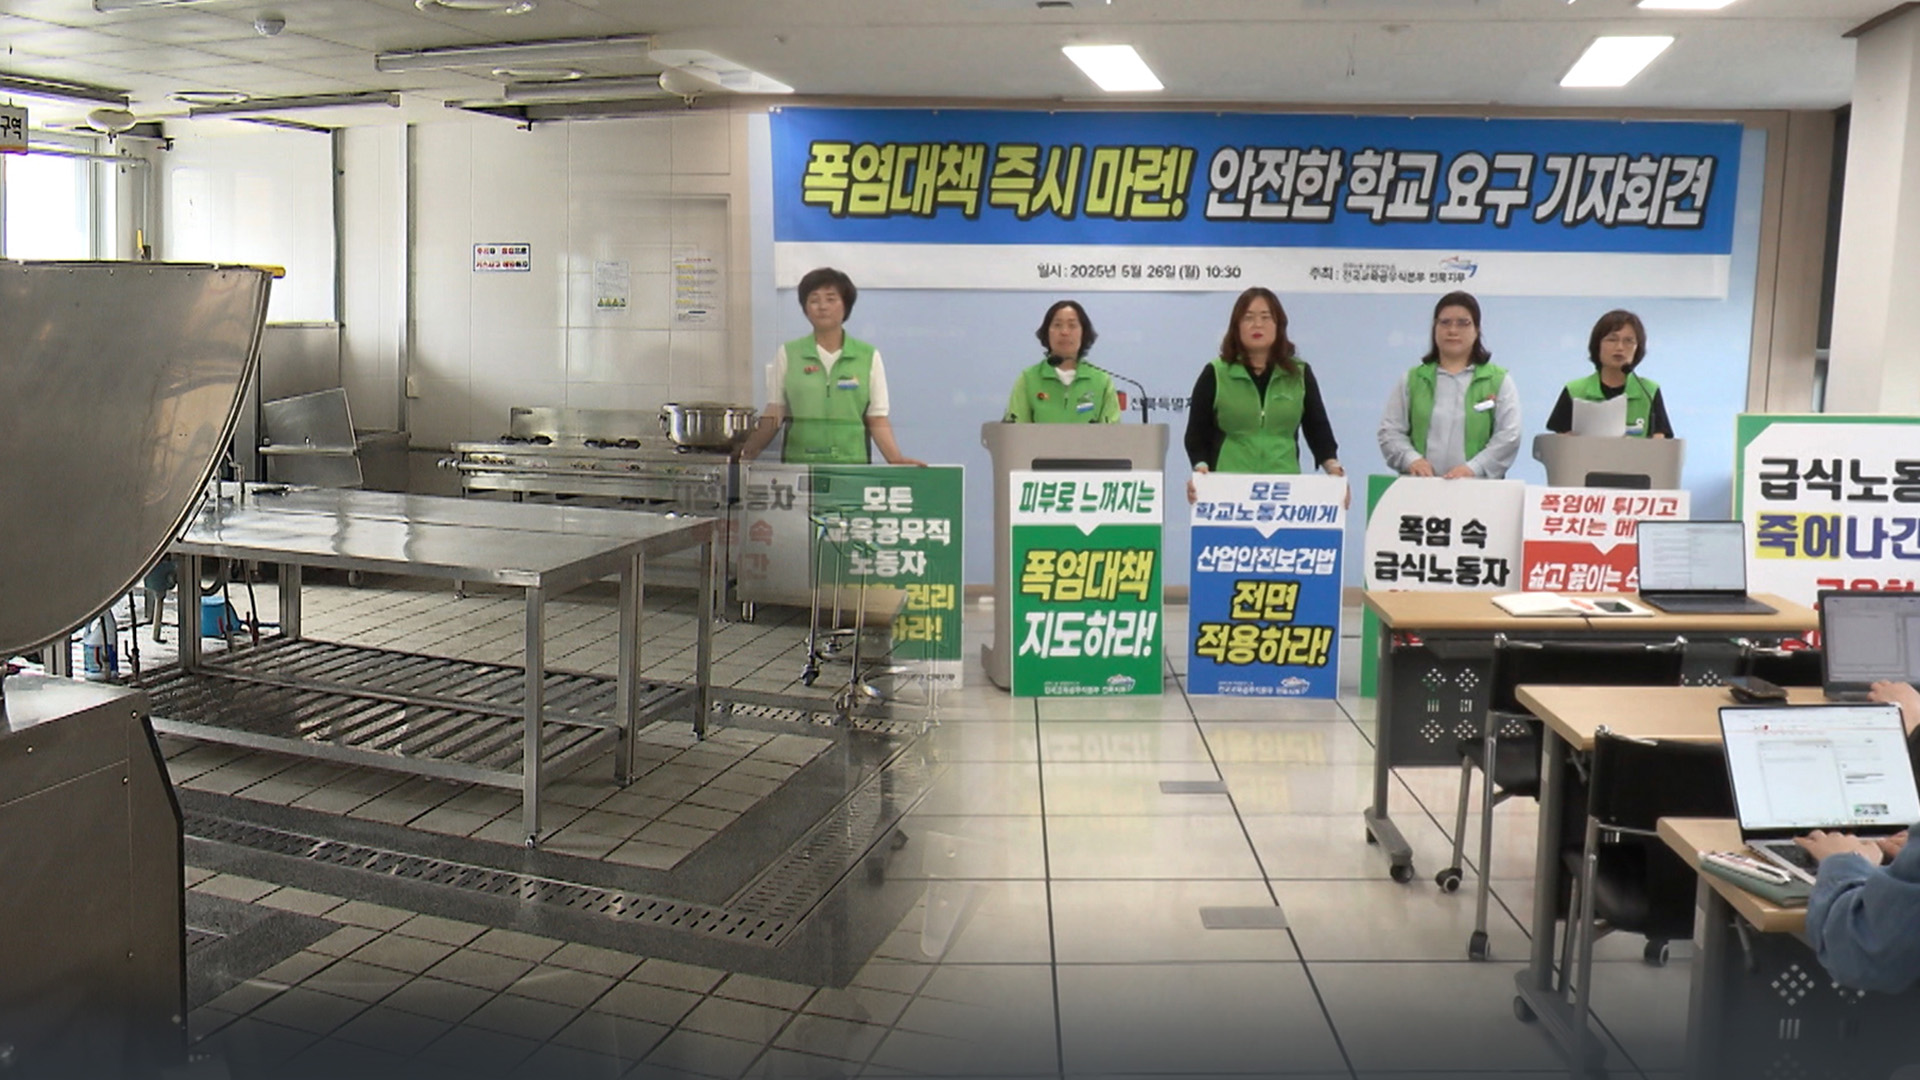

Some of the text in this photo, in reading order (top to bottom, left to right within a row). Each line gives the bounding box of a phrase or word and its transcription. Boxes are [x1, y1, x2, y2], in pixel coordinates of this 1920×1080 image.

[0, 115, 22, 140] 구역
[802, 142, 1715, 227] 폭염대책 즉시 마련! 안전한 학교 요구 기자회견
[1206, 265, 1241, 279] 10:30
[862, 486, 914, 513] 모든
[1018, 480, 1155, 513] 피부로 느껴지는
[1249, 481, 1291, 502] 모든
[1540, 494, 1679, 517] 폭염에 튀기고
[1195, 501, 1338, 524] 학교노동자에게
[1542, 516, 1607, 537] 부치는
[1398, 514, 1488, 549] 폭염 속
[849, 550, 927, 577] 노동자
[1020, 548, 1155, 602] 폭염대책
[1196, 544, 1337, 576] 산업안전보건법
[1373, 550, 1510, 588] 급식노동자
[1527, 561, 1567, 591] 삶고
[905, 583, 955, 611] 권리
[1230, 579, 1300, 621] 전면
[1018, 609, 1158, 659] 지도하라!
[1196, 622, 1333, 667] 적용하라!
